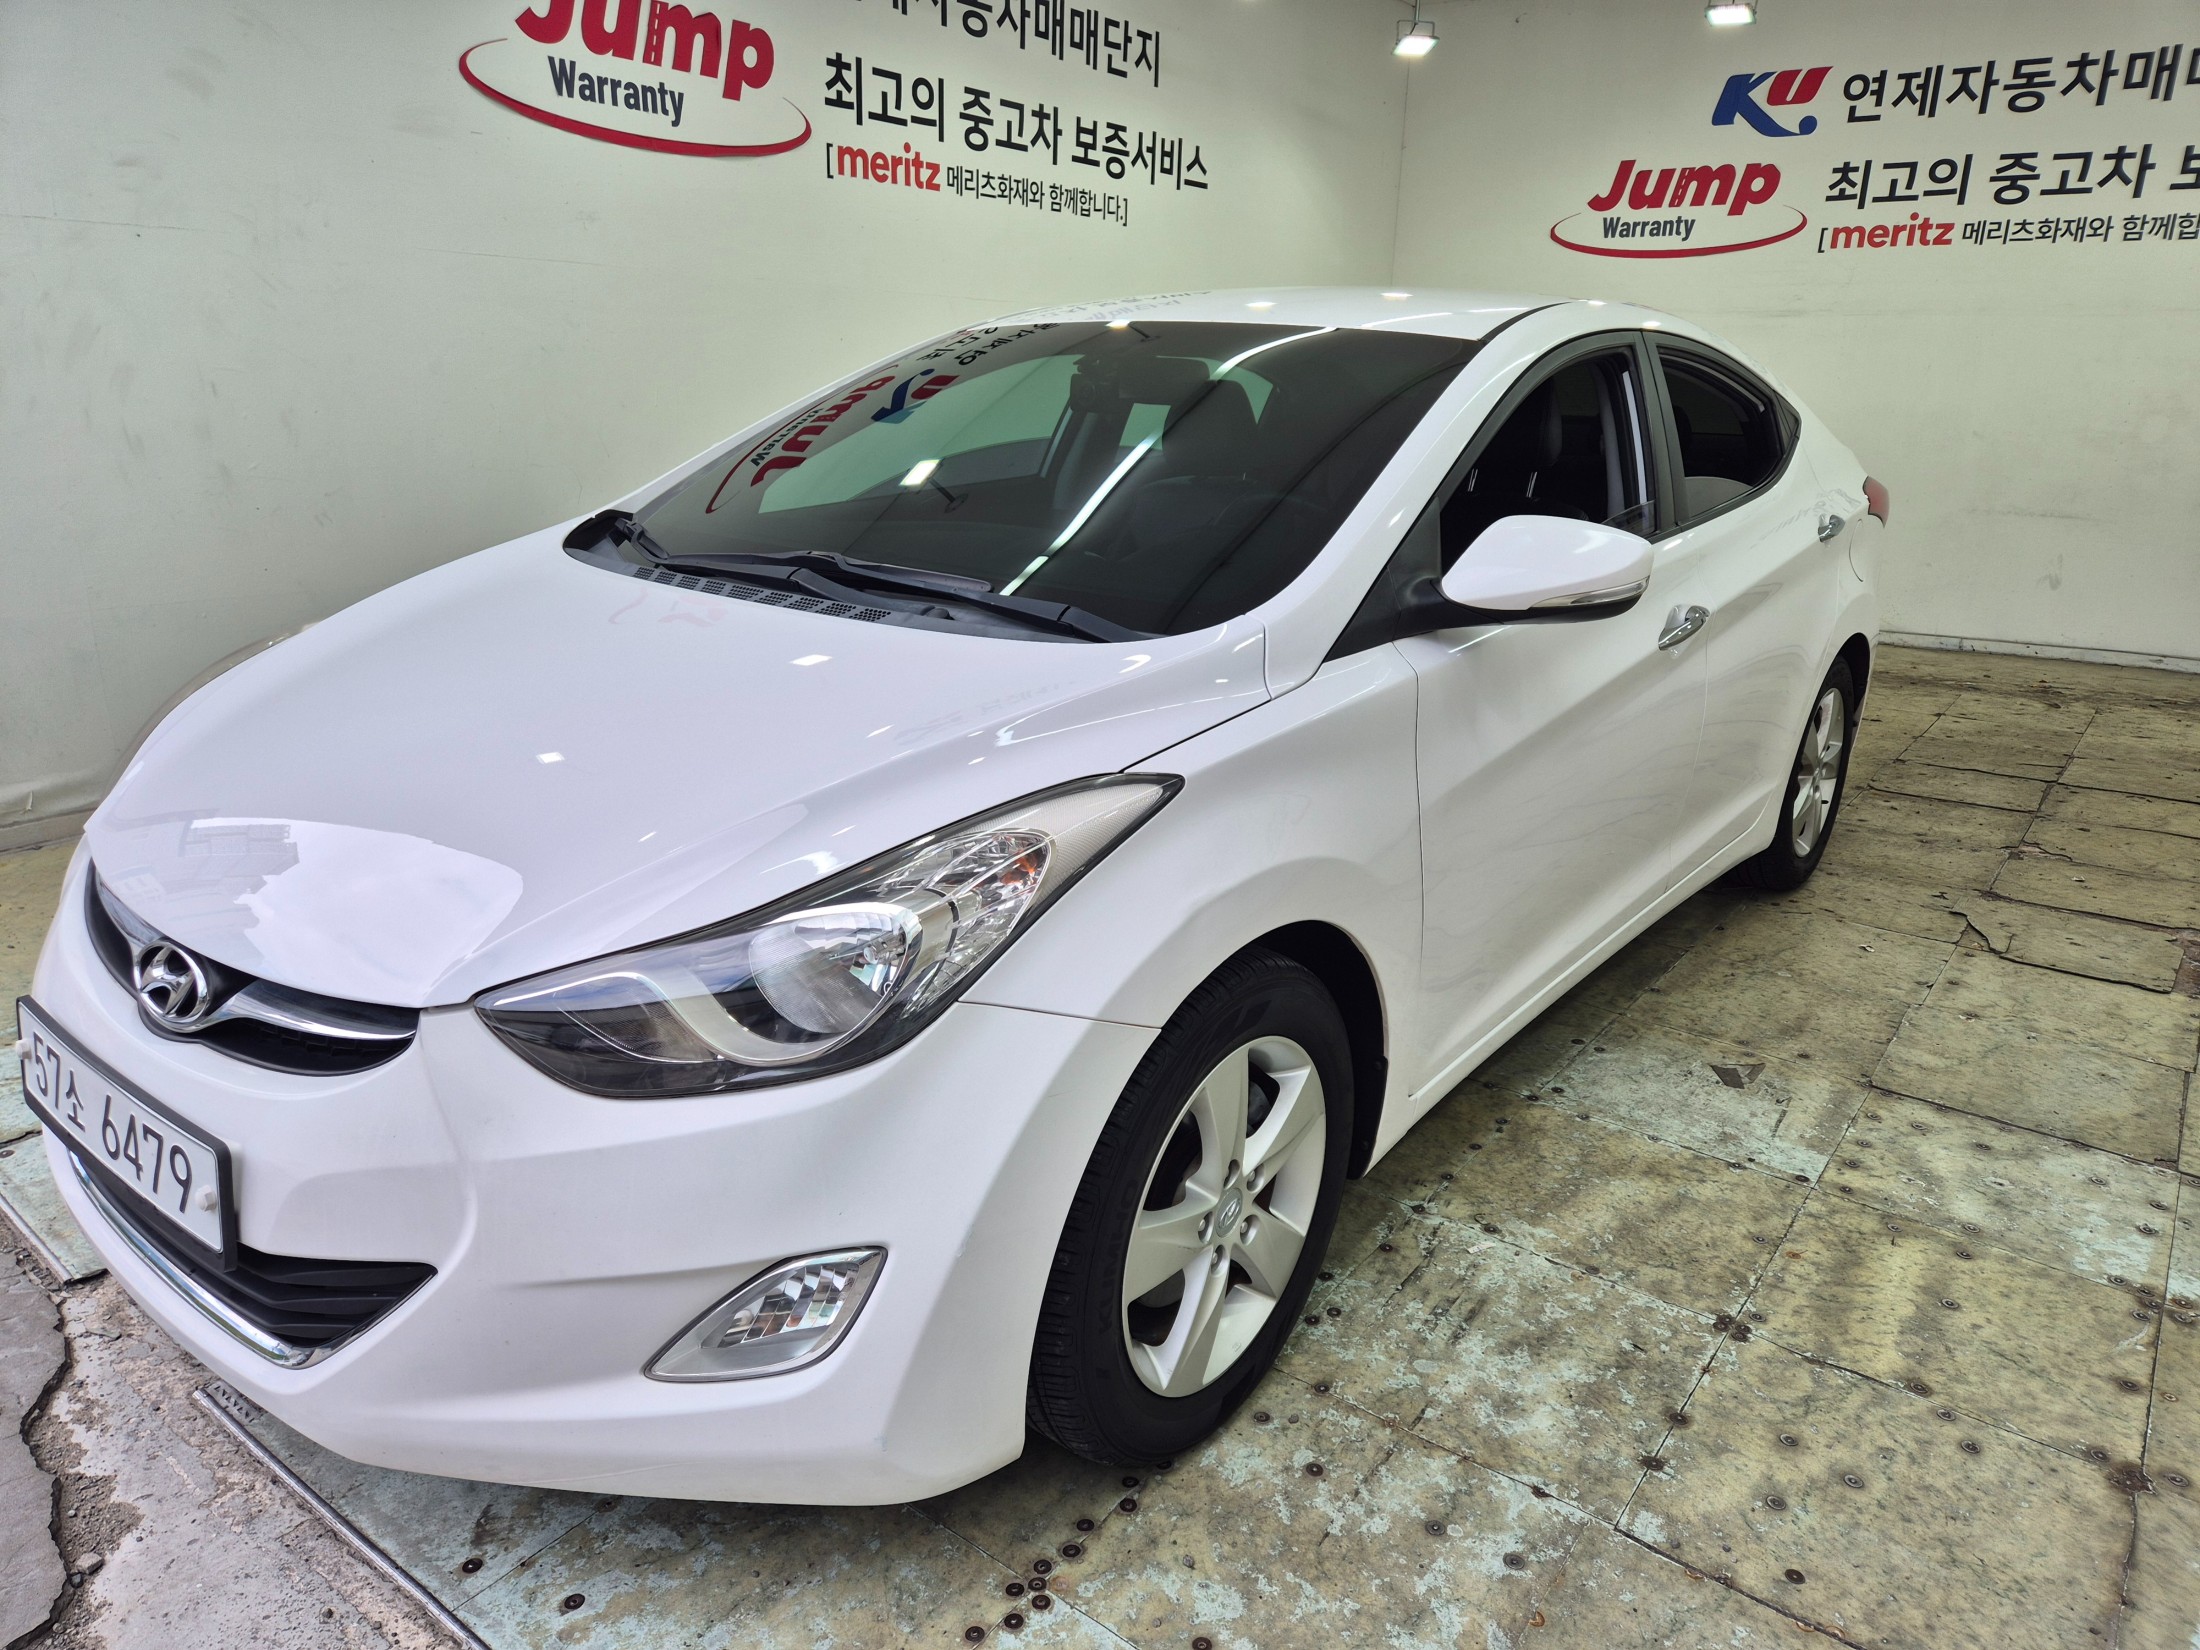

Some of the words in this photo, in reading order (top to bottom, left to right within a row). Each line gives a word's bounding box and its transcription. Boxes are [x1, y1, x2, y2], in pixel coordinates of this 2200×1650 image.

[515, 0, 775, 101] Jump
[1843, 43, 2200, 123] 연제자동차매
[547, 55, 685, 127] Warranty
[824, 51, 945, 142] 최고의
[959, 86, 1063, 166] 중고차
[1072, 116, 1209, 190] 보증서비스
[946, 165, 1046, 210] 메리츠화재와
[1049, 183, 1129, 226] 함께합니다.]
[1587, 159, 1782, 216] Jump
[1825, 154, 1974, 210] 최고의
[1989, 143, 2157, 205] 중고차
[1602, 216, 1696, 241] Warranty
[1962, 215, 2114, 246] 메리츠화재와
[32, 1031, 86, 1132] 57소
[101, 1093, 193, 1214] 6479
